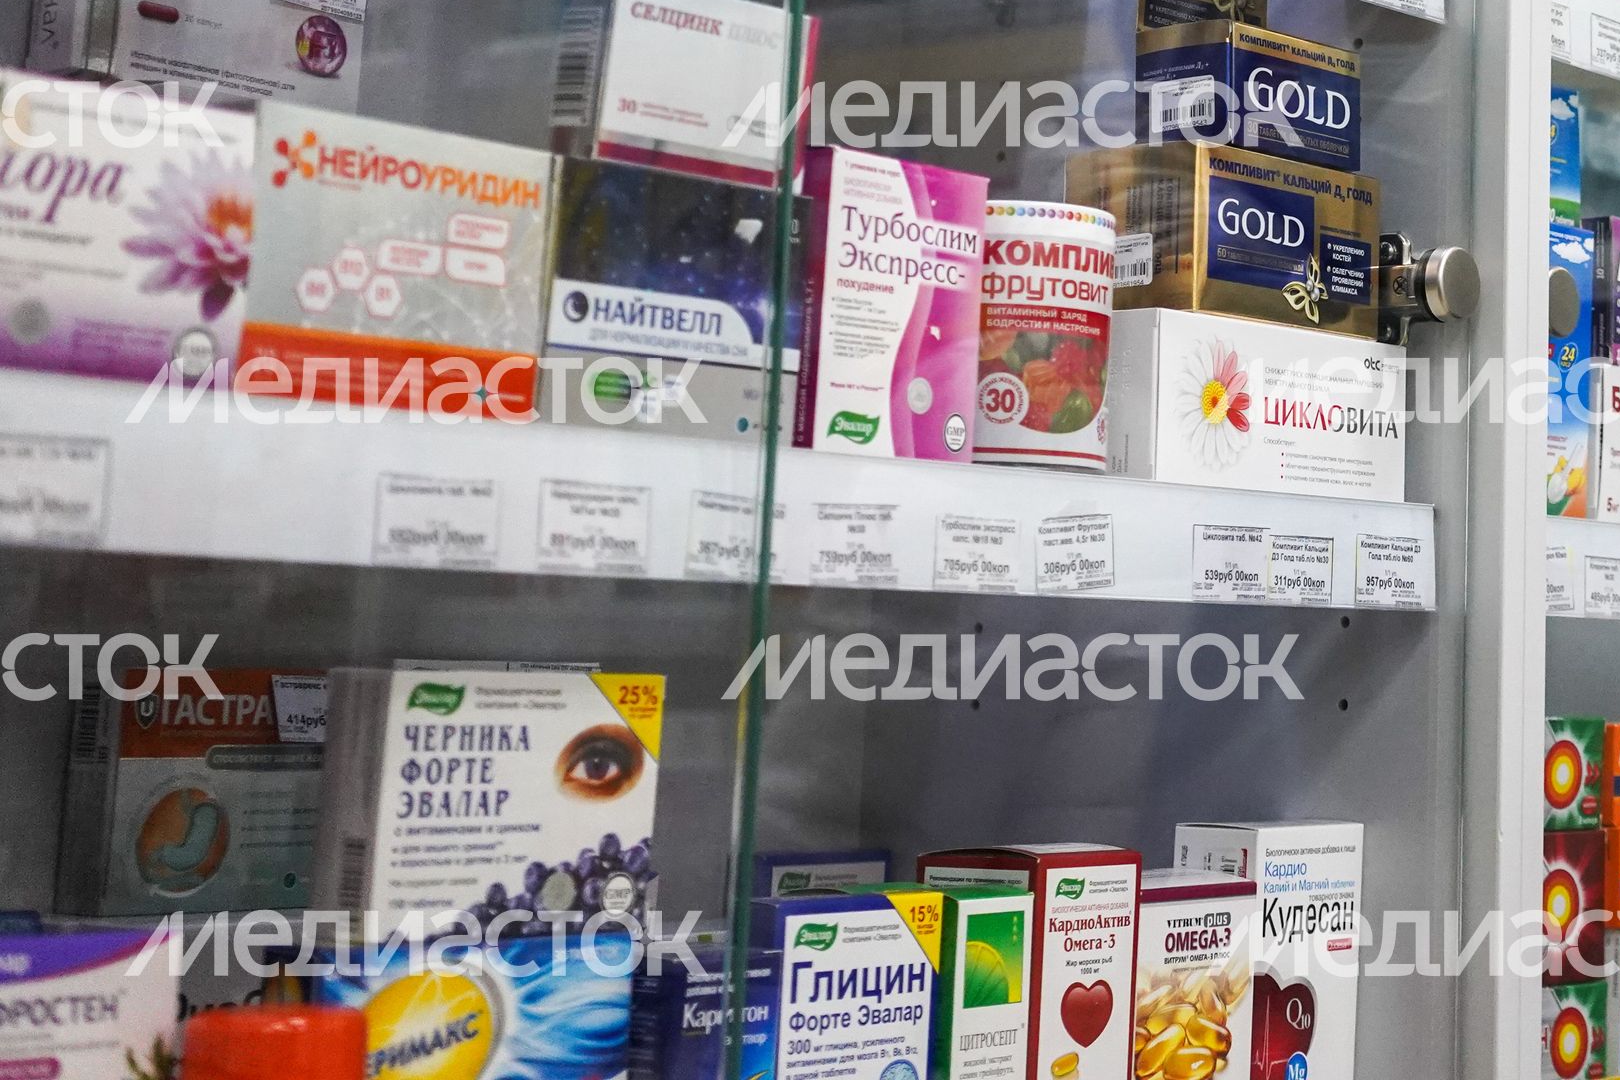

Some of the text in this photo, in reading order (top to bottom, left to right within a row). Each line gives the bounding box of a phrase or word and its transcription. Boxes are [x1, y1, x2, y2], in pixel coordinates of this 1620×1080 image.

[629, 1, 723, 37] СЕЛЦИНК
[1239, 33, 1326, 64] КОМПЛИВИТ КАЛЬЦИЙ
[1248, 67, 1350, 130] GOLD
[318, 144, 541, 210] НЕЙРОУРИДИН
[1209, 157, 1372, 206] КОМПЛИВИТ КАЛЬЦИЙ ГОЛД
[841, 205, 977, 254] Турбослим
[1217, 198, 1305, 248] GOLD
[837, 277, 894, 295] похудение
[592, 294, 722, 337] НАЙТВЕЛЛ
[1561, 345, 1576, 362] 24
[1265, 396, 1399, 439] ЦИКЛОВИТА
[1203, 531, 1233, 542] Цикловита
[1391, 543, 1413, 554] Кальций
[1044, 561, 1076, 575] 306руб
[1204, 570, 1258, 582] 539руб 00коп
[1274, 576, 1325, 589] 311руб 00коп
[1366, 576, 1415, 590] 957руб 00коп
[618, 685, 658, 706] 25%
[404, 724, 530, 752] ЧЕРНИКА
[400, 758, 495, 785] ФОРТЕ
[396, 789, 510, 819] ЭВАЛАР
[1264, 861, 1307, 878] Кардио
[1263, 878, 1329, 894] Калий Магний
[909, 903, 939, 923] 15%
[1048, 912, 1130, 935] КардиоАктив
[1207, 914, 1228, 929] plus
[1262, 897, 1354, 946] Кудесан
[1064, 935, 1116, 954] Омега-3
[1165, 927, 1231, 954] OMEGA-3
[1079, 955, 1112, 968] морских рыб
[790, 961, 926, 1005] Глицин
[789, 1004, 923, 1036] Форте Эвалар
[787, 1036, 905, 1055] 300 усиленного
[960, 1029, 1018, 1052] ЦИТРОСЕПТ
[786, 1054, 854, 1069] витаминами для
